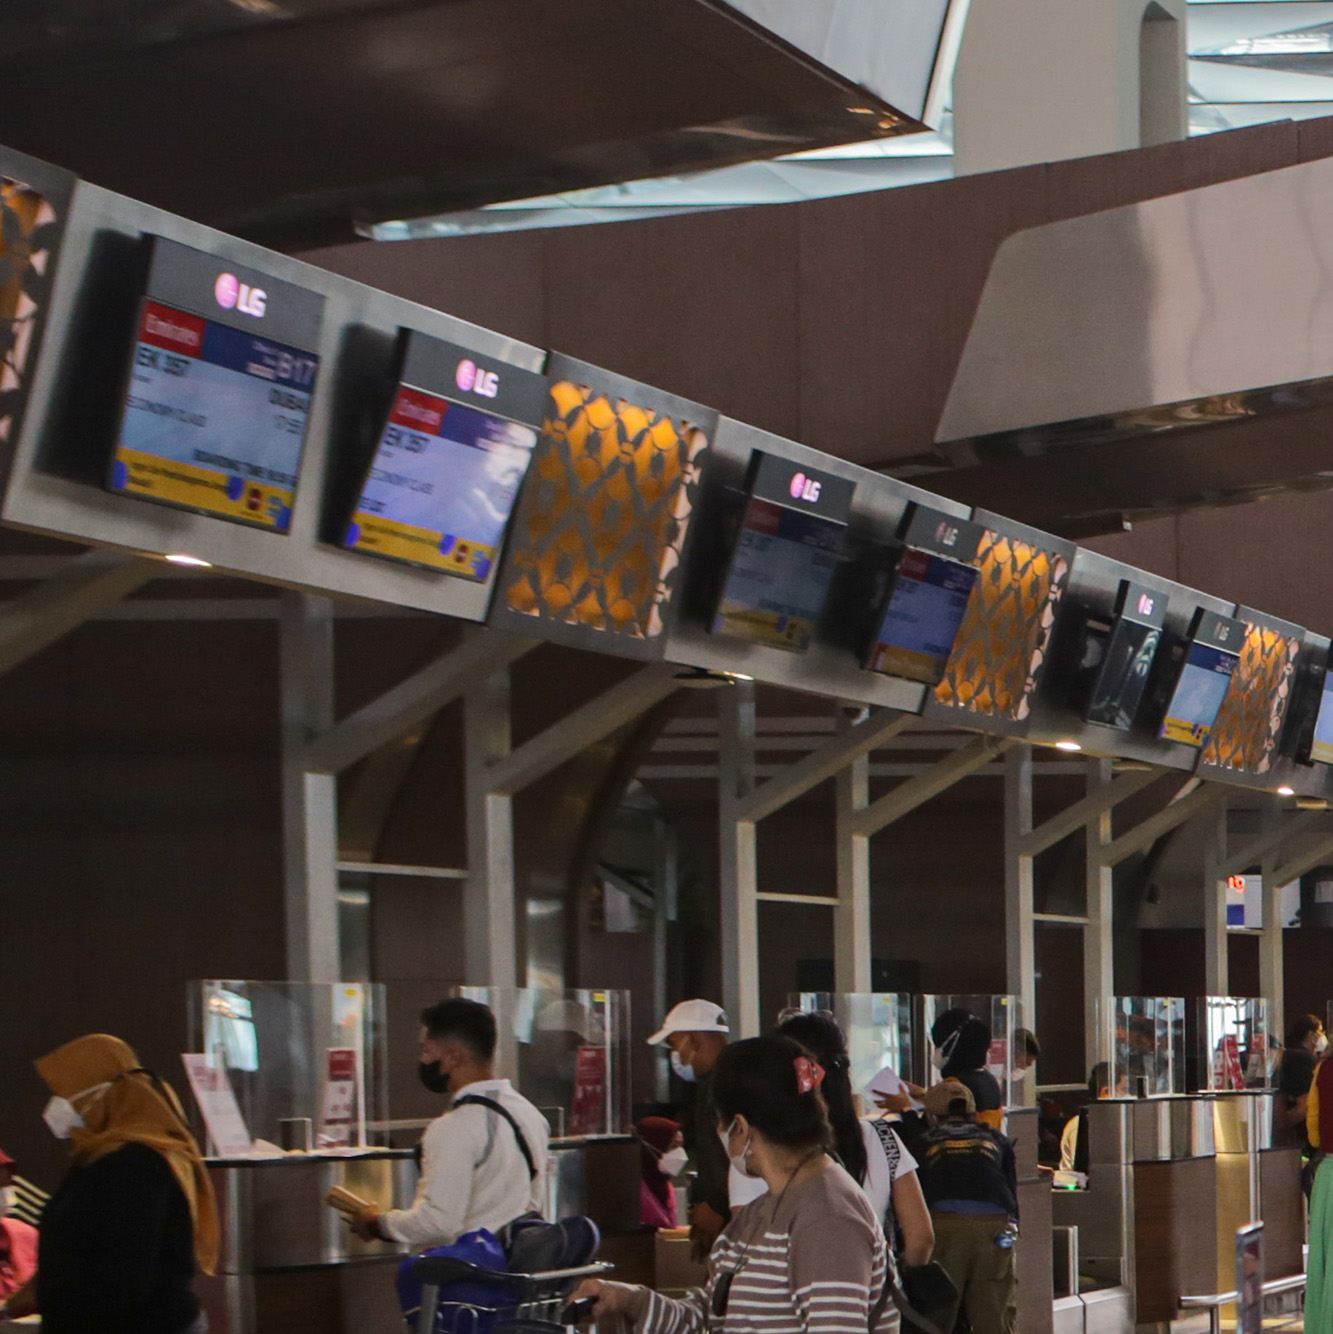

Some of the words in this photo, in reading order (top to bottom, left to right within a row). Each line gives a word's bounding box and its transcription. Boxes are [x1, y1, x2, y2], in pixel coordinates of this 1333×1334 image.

[236, 283, 268, 319] LG
[472, 367, 500, 399] LG
[801, 477, 822, 503] LG
